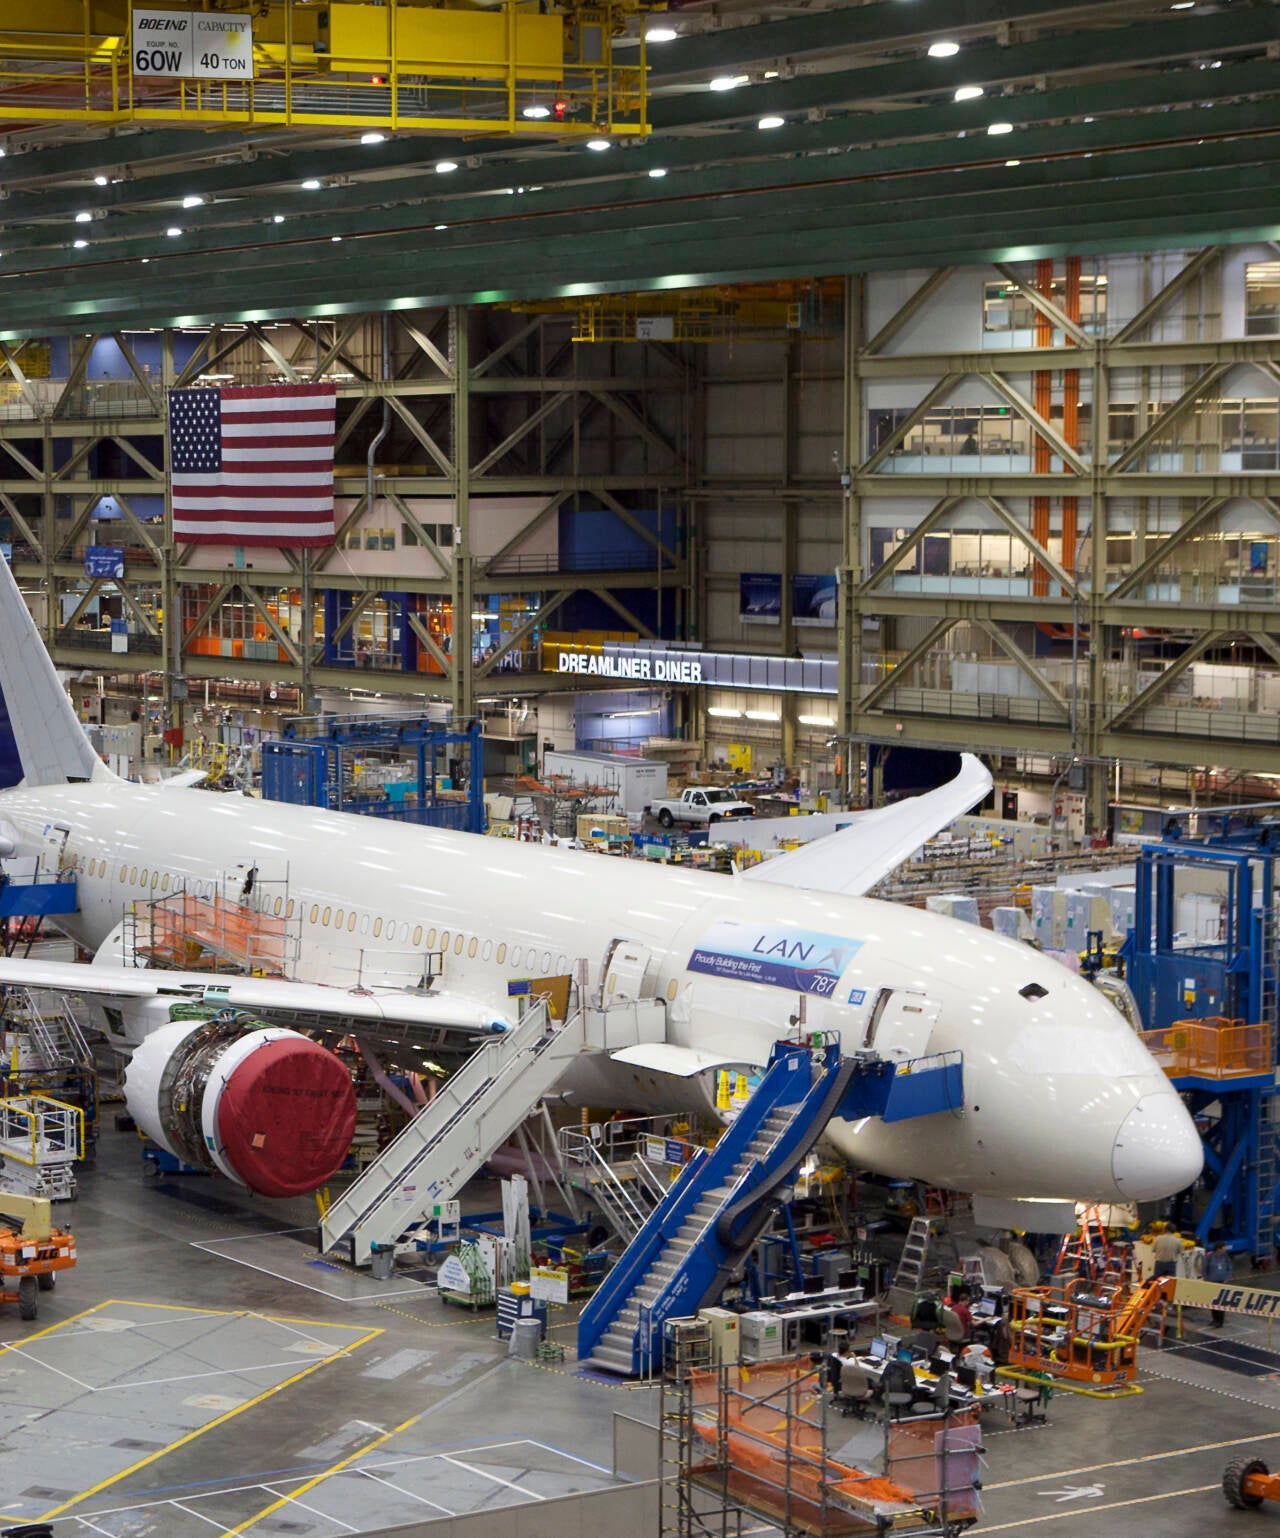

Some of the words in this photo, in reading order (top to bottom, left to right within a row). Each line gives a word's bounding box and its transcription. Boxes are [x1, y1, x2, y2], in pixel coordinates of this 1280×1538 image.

[138, 18, 187, 31] BOEING
[197, 20, 248, 32] CAPACITY
[200, 53, 219, 69] 40
[222, 58, 246, 70] TON
[558, 652, 650, 680] DREAMLINER
[654, 659, 701, 683] DINER
[752, 935, 815, 961] LAN
[715, 957, 738, 970] Building
[748, 963, 762, 973] First
[810, 975, 837, 993] 787
[1211, 1288, 1244, 1307] JLG
[1245, 1293, 1280, 1312] LIFT
